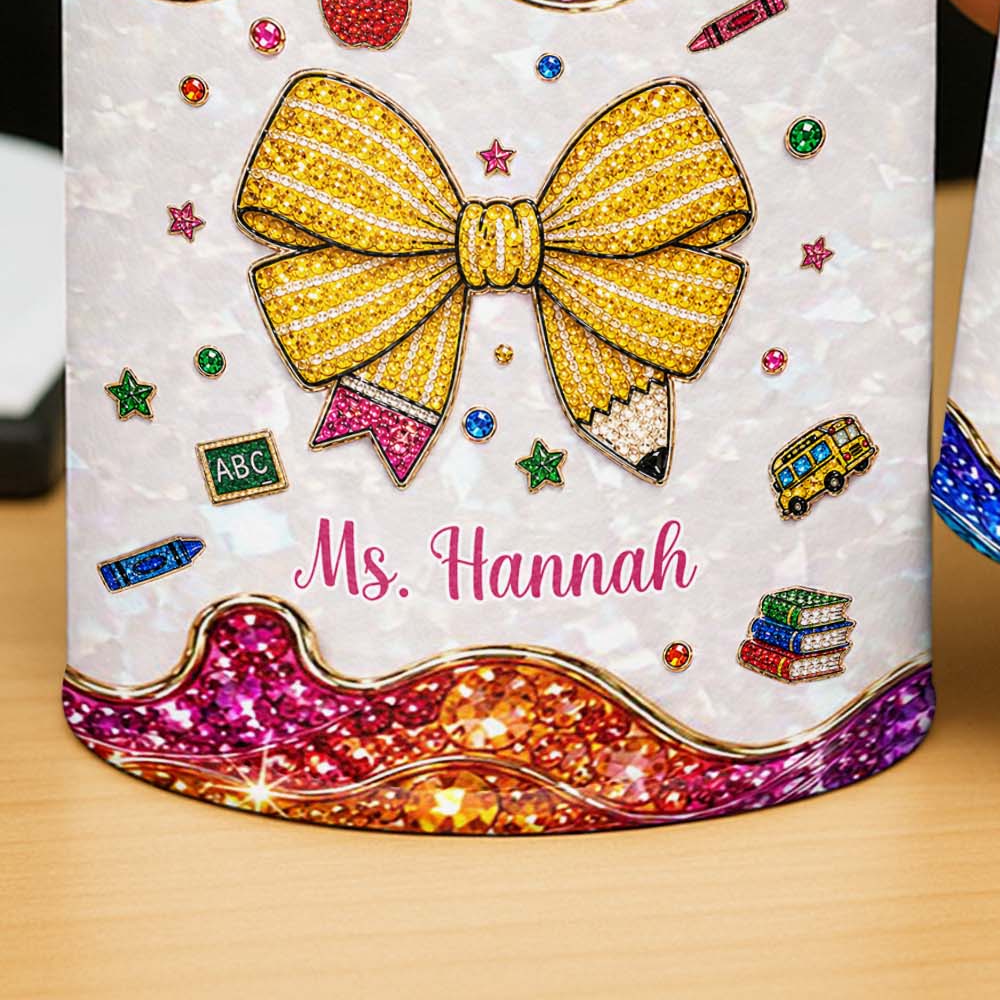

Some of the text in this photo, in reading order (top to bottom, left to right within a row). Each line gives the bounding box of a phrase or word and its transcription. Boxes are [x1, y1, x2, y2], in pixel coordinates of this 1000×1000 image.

[215, 450, 268, 483] ABC
[293, 517, 698, 601] Ms. Hannah
